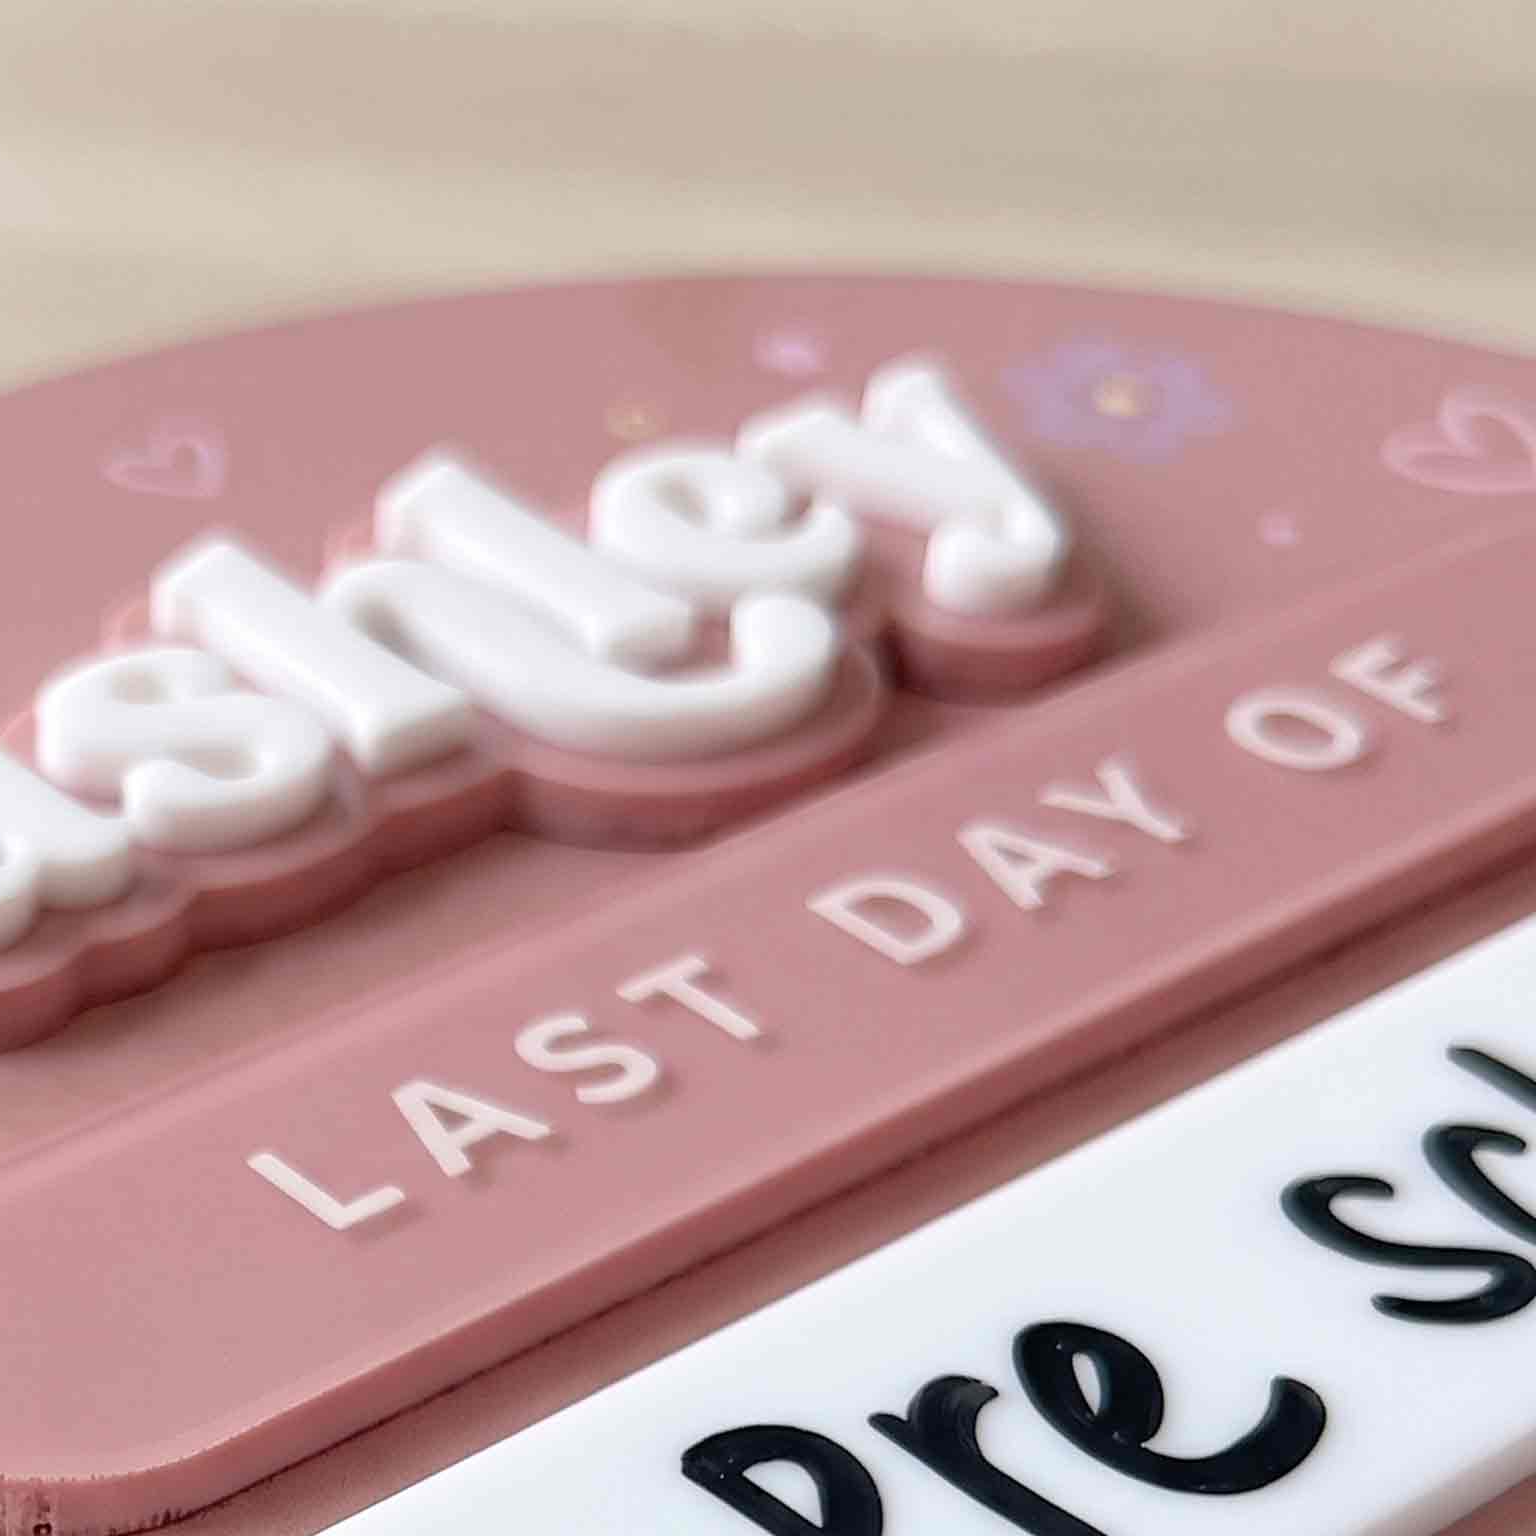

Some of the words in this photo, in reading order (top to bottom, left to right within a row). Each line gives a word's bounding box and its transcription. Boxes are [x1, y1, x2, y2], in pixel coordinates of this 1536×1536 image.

[244, 951, 764, 1232] LAST
[804, 756, 1187, 966] DAY
[1223, 635, 1450, 771] OF
